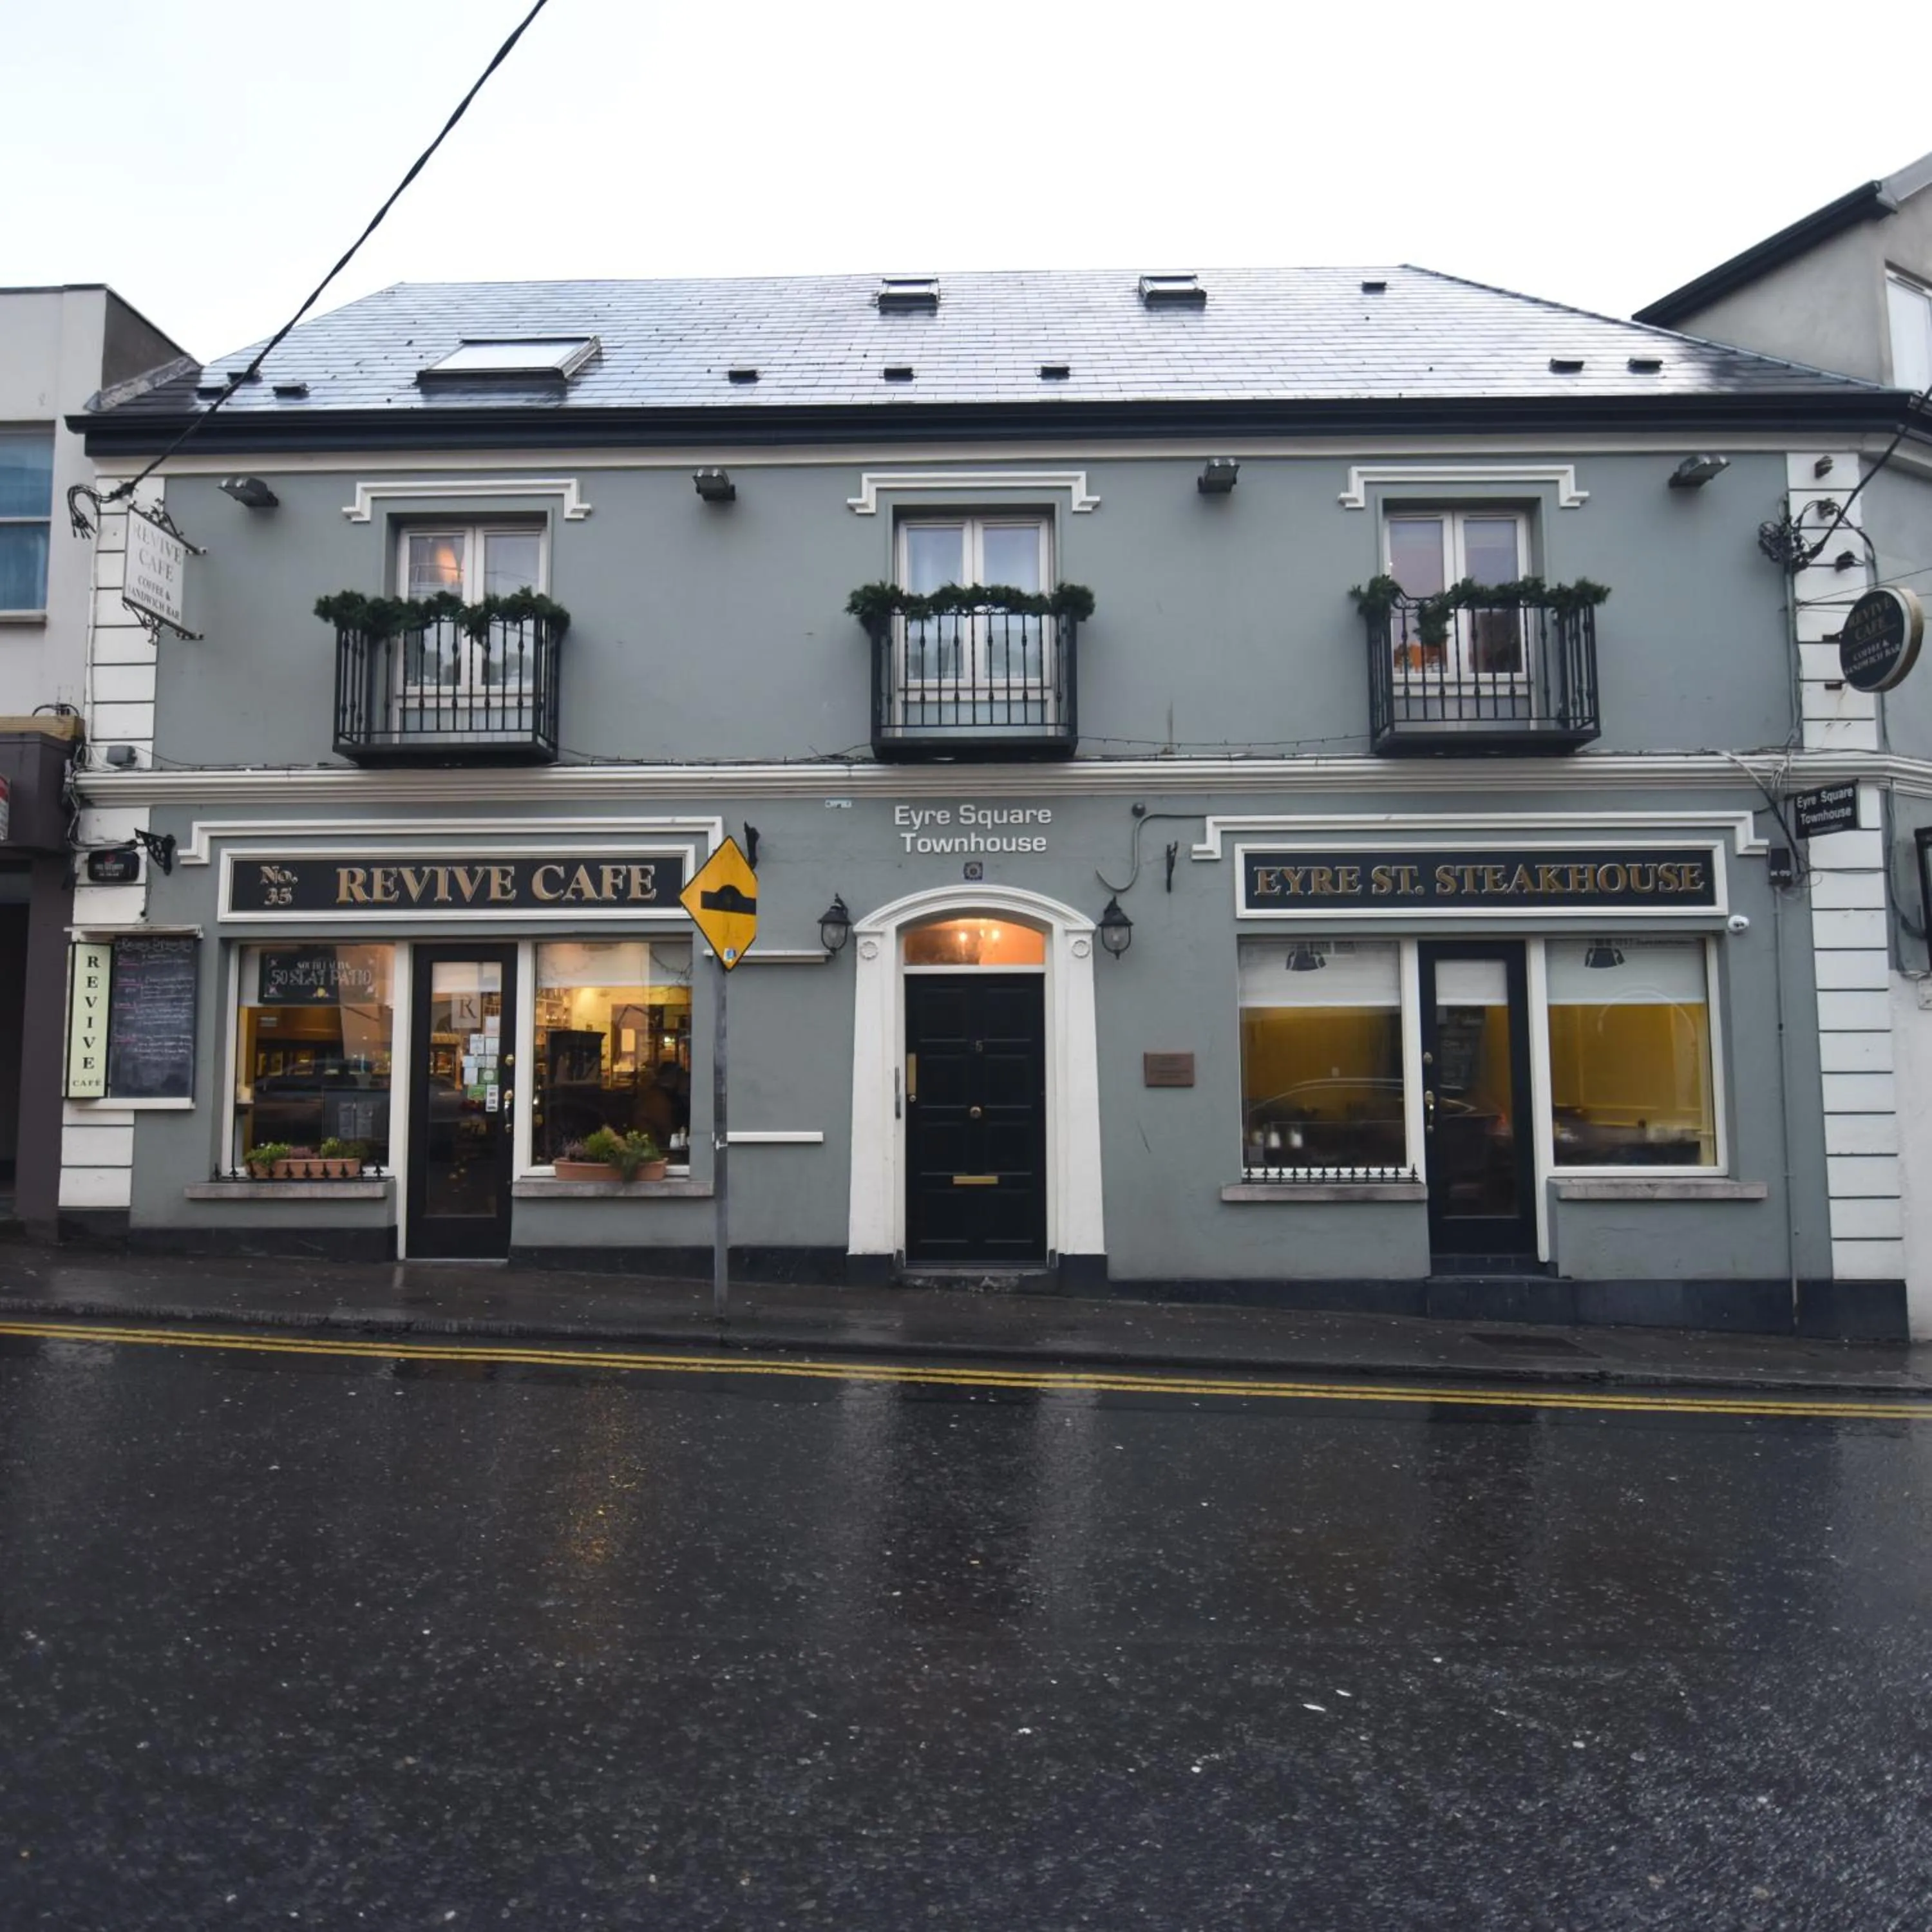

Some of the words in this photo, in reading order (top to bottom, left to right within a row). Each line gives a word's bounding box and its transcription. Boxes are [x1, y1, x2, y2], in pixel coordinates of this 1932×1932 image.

[138, 548, 173, 582] CAFE
[137, 575, 164, 598] COFFEE
[165, 590, 171, 601] &
[1797, 795, 1817, 810] Eyre
[1821, 787, 1853, 803] Square
[895, 805, 951, 830] Eyre
[959, 804, 1052, 829] Square
[1801, 807, 1852, 824] Townhouse
[900, 832, 1047, 853] Townhouse
[336, 865, 517, 903] REVIVE
[531, 864, 658, 901] CAFE
[1253, 866, 1363, 896] EYRE
[1371, 865, 1425, 896] ST.
[1435, 862, 1705, 895] STEAKHOUSE
[264, 887, 293, 905] 35
[271, 969, 288, 985] 50
[330, 969, 372, 986] PATIO
[82, 956, 100, 1070] REVIVE
